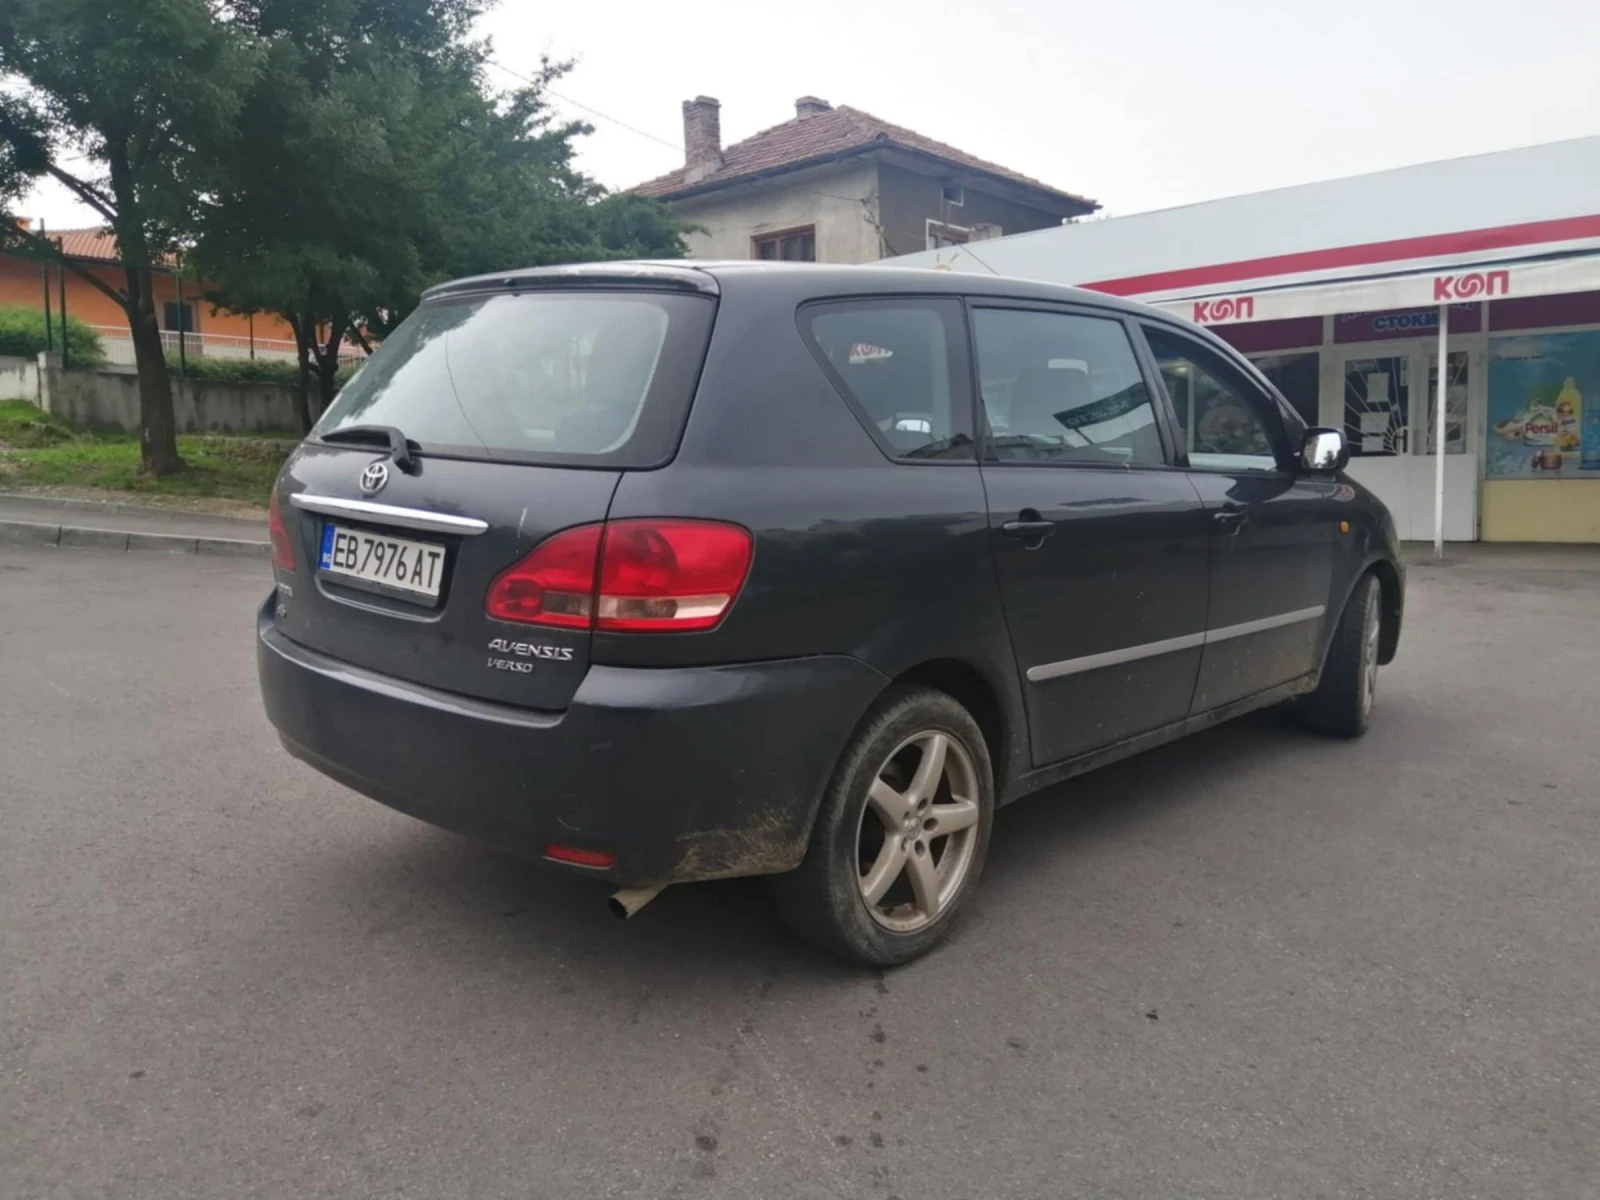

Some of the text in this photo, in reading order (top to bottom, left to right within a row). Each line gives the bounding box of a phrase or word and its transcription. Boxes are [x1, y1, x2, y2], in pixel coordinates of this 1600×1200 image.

[1525, 421, 1559, 435] Persil
[488, 638, 575, 661] AVENSIS
[487, 657, 533, 673] VERSO
